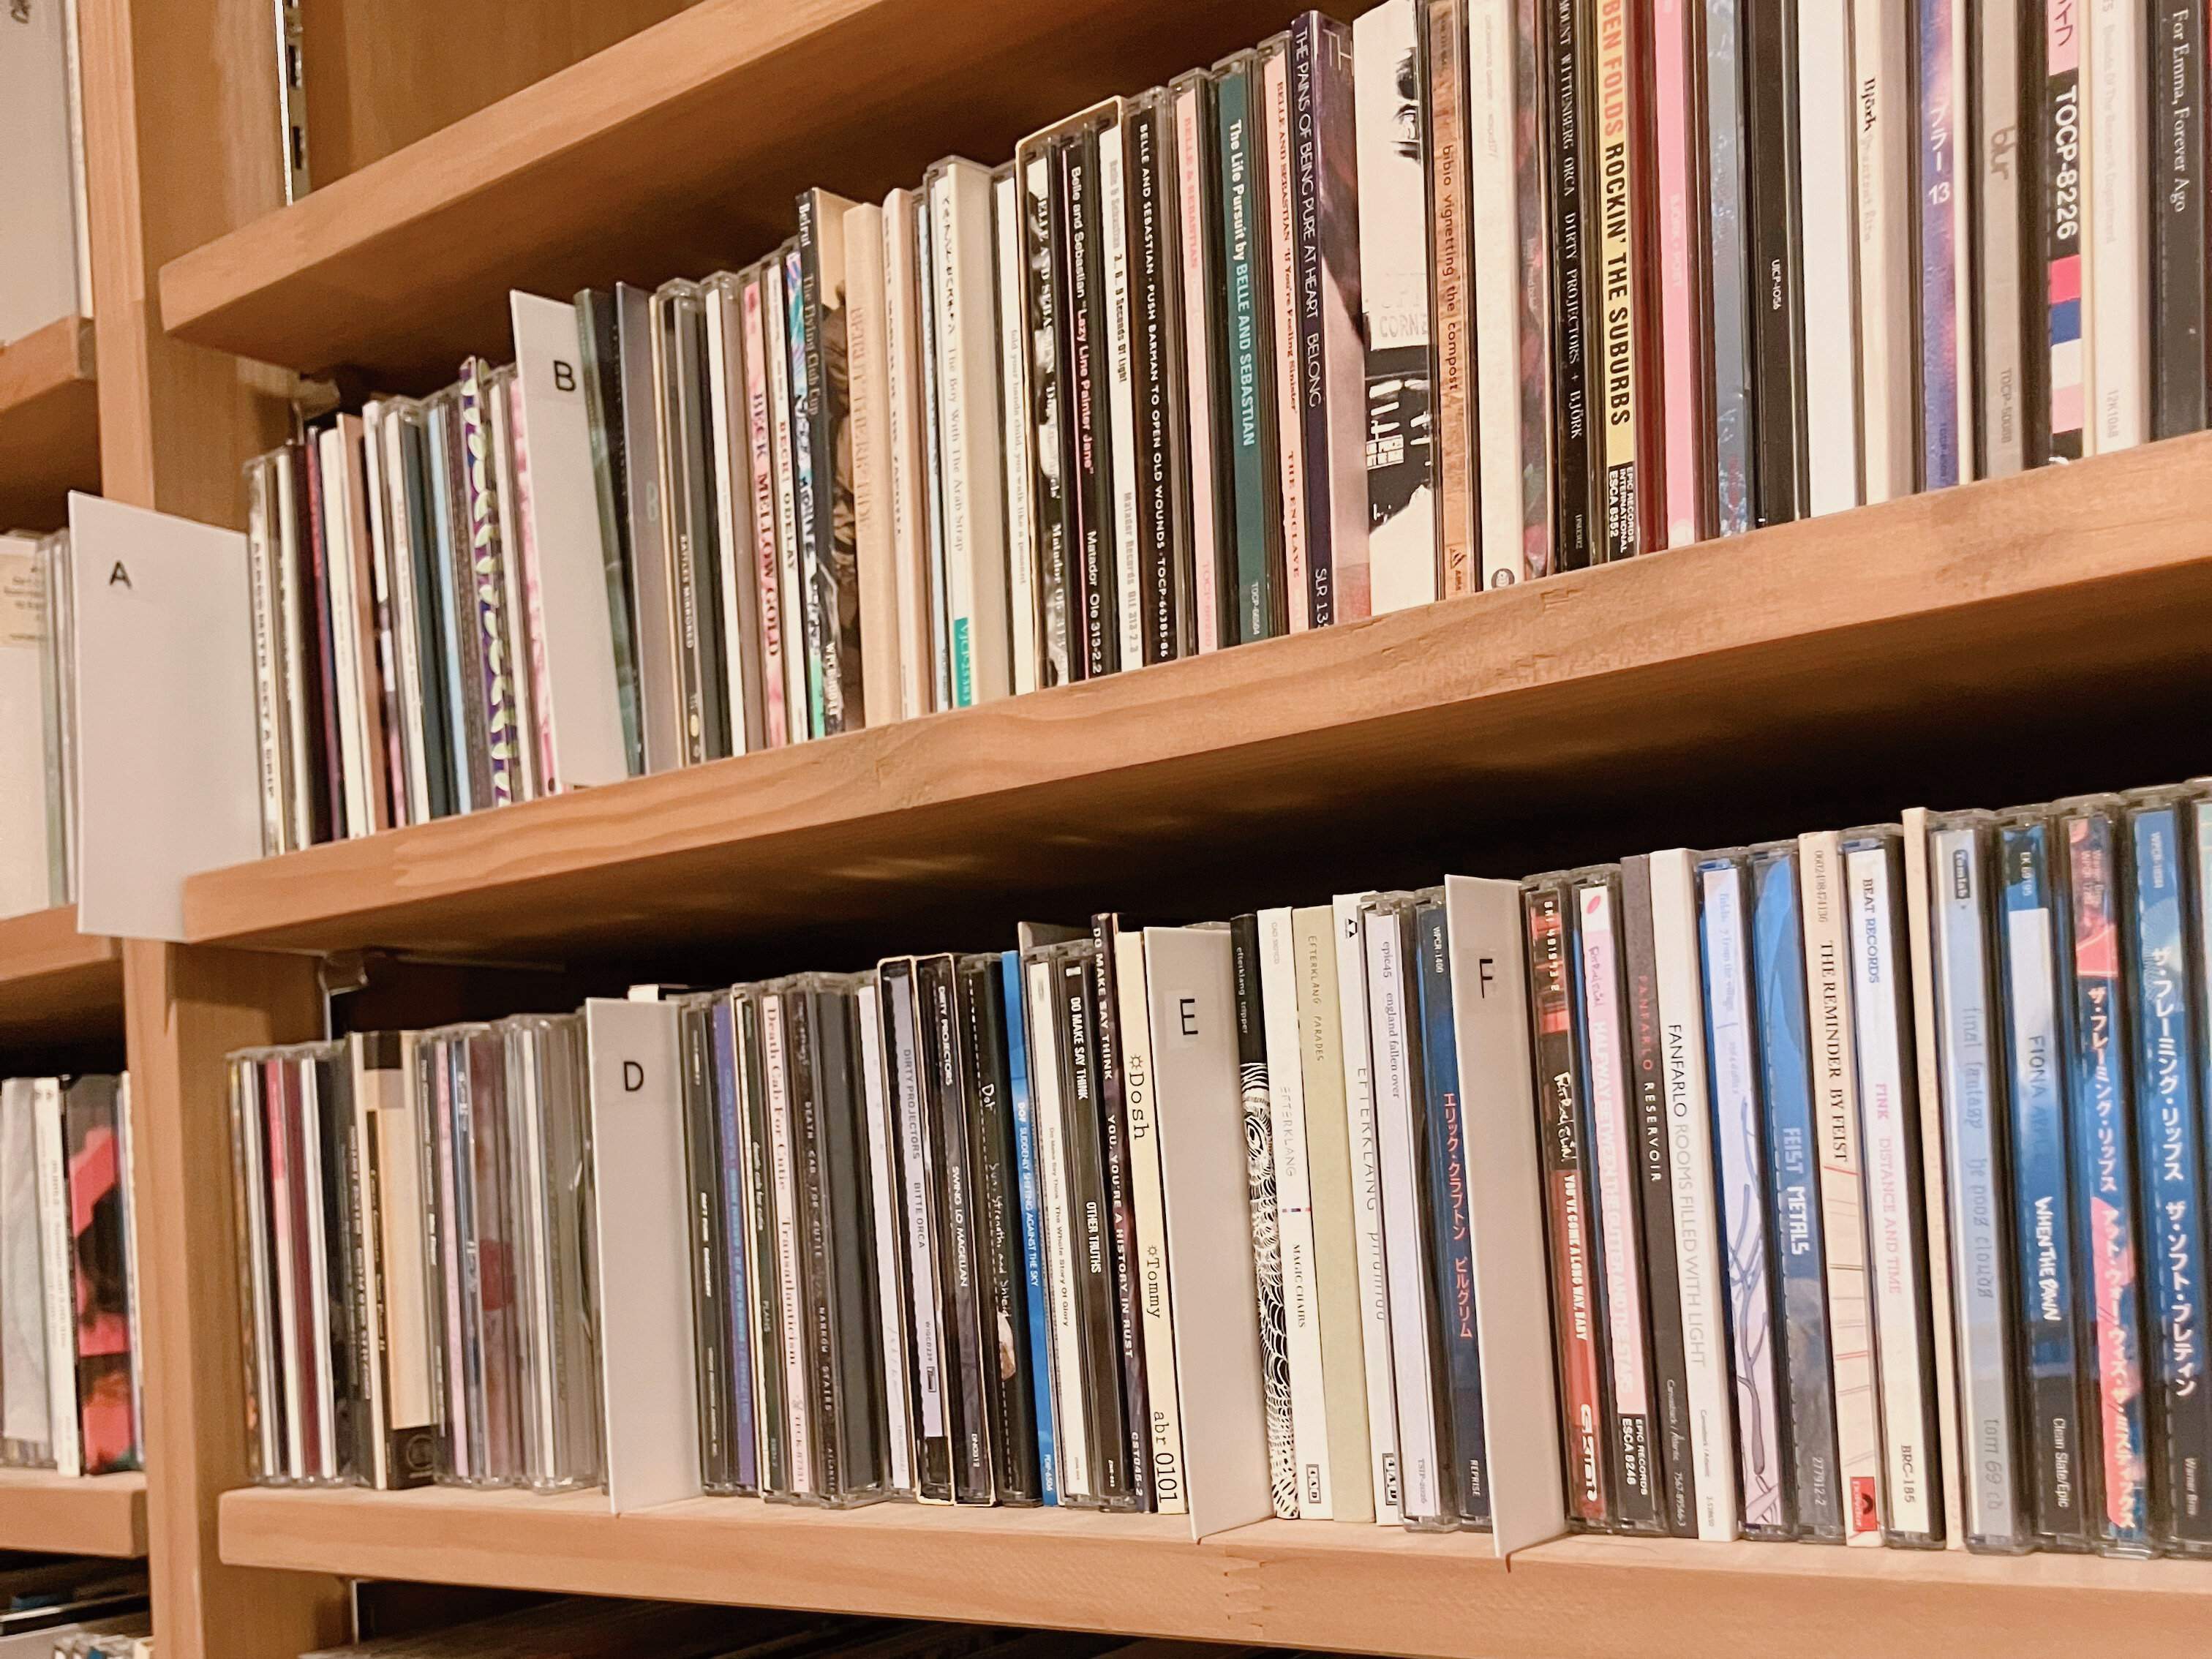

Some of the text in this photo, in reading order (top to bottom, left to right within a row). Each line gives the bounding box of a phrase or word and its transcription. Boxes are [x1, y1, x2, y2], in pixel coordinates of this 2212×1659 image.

[1276, 81, 1286, 127] BELLE
[2169, 8, 2190, 213] For Emma, Forever Ago
[2052, 84, 2078, 241] TOCP-8226
[1184, 116, 1198, 269] BELLE SEBASTIAN
[1279, 162, 1290, 241] SEBASTIAN
[1560, 53, 1579, 364] WITTENBERG ORCA DIRTY PROJECTORS
[1928, 180, 1950, 206] 13
[797, 203, 813, 247] Beirut
[1602, 55, 1630, 426] FOLDS ROCKIN' THE SUBURBS
[801, 274, 816, 301] The
[1229, 118, 1255, 446] The Life Pursuit by BELLE AND SEBASTIAN
[1440, 144, 1459, 391] bibio vignetting the compost
[802, 305, 819, 351] Flying
[1294, 26, 1328, 598] THE PAINS OF BEING PURE AT HEART BELONG SLR
[1138, 123, 1166, 549] BELLE AND SEBASTIAN PUSH BARMAN TO OPEN OLD WOUNDS
[553, 361, 576, 391] B
[805, 354, 821, 385] Club
[1070, 165, 1100, 617] Belle and Sebastian Line Painter Matador Ole
[807, 388, 821, 415] Cup
[950, 407, 961, 445] With
[952, 448, 962, 474] The
[953, 478, 964, 512] Arab
[1608, 470, 1619, 505] ESCA
[752, 394, 779, 657] BECK MELLOW GOLD
[783, 492, 797, 571] ODELAY
[953, 514, 966, 551] Strap
[1625, 492, 1635, 543] RECORDS
[109, 560, 132, 588] A
[1092, 927, 1102, 948] DO
[1380, 941, 1393, 978] epic45
[1095, 952, 1105, 996] MAKE
[1235, 947, 1249, 1034] efterklang tripper
[1479, 958, 1493, 999] F
[937, 985, 949, 1015] DIRTY
[1098, 1000, 1107, 1029] SAY
[1180, 998, 1198, 1035] E
[1308, 936, 1324, 1062] EFTERKLANG PARADES
[1384, 992, 1397, 1037] england
[767, 1007, 779, 1060] Death
[940, 1018, 955, 1086] PROJECTORS
[1388, 1039, 1400, 1071] fallen
[1819, 941, 1848, 1163] THE REMINDER BY FEIST
[623, 1061, 644, 1091] D
[1101, 1034, 1112, 1080] THINK
[904, 1048, 927, 1249] DIRTY PROJECTORS BITTE ORCA
[1069, 996, 1101, 1274] DO MAKE SAY THINK OTHER TRUTHS
[1644, 1082, 1662, 1182] RESERVOIR
[951, 1165, 962, 1203] SWING
[1669, 1023, 1706, 1368] FANFARLO ROOMS FILLED WITH LIGHT
[1782, 1126, 1809, 1255] FEIST METALS
[1862, 877, 1915, 1502] BEAT RECORDS PINK BRC-185
[955, 1227, 968, 1287] MAGELLAN
[1116, 1227, 1127, 1290] HISTORY
[2026, 1034, 2065, 1451] FIONA WHEN THE PAWN Clean
[1029, 1269, 1039, 1287] SKY
[1129, 1072, 1178, 1504] Dosh Tommy abr 0101
[1292, 1244, 1305, 1328] MAGIC CHAIRS
[1123, 1319, 1133, 1358] RUST
[822, 1365, 832, 1411] STAIRS
[1621, 1417, 1633, 1450] ESCA
[1469, 1458, 1481, 1497] REPRISE
[1634, 1418, 1648, 1496] EPIC RECORDS
[1985, 1459, 2004, 1483] 69
